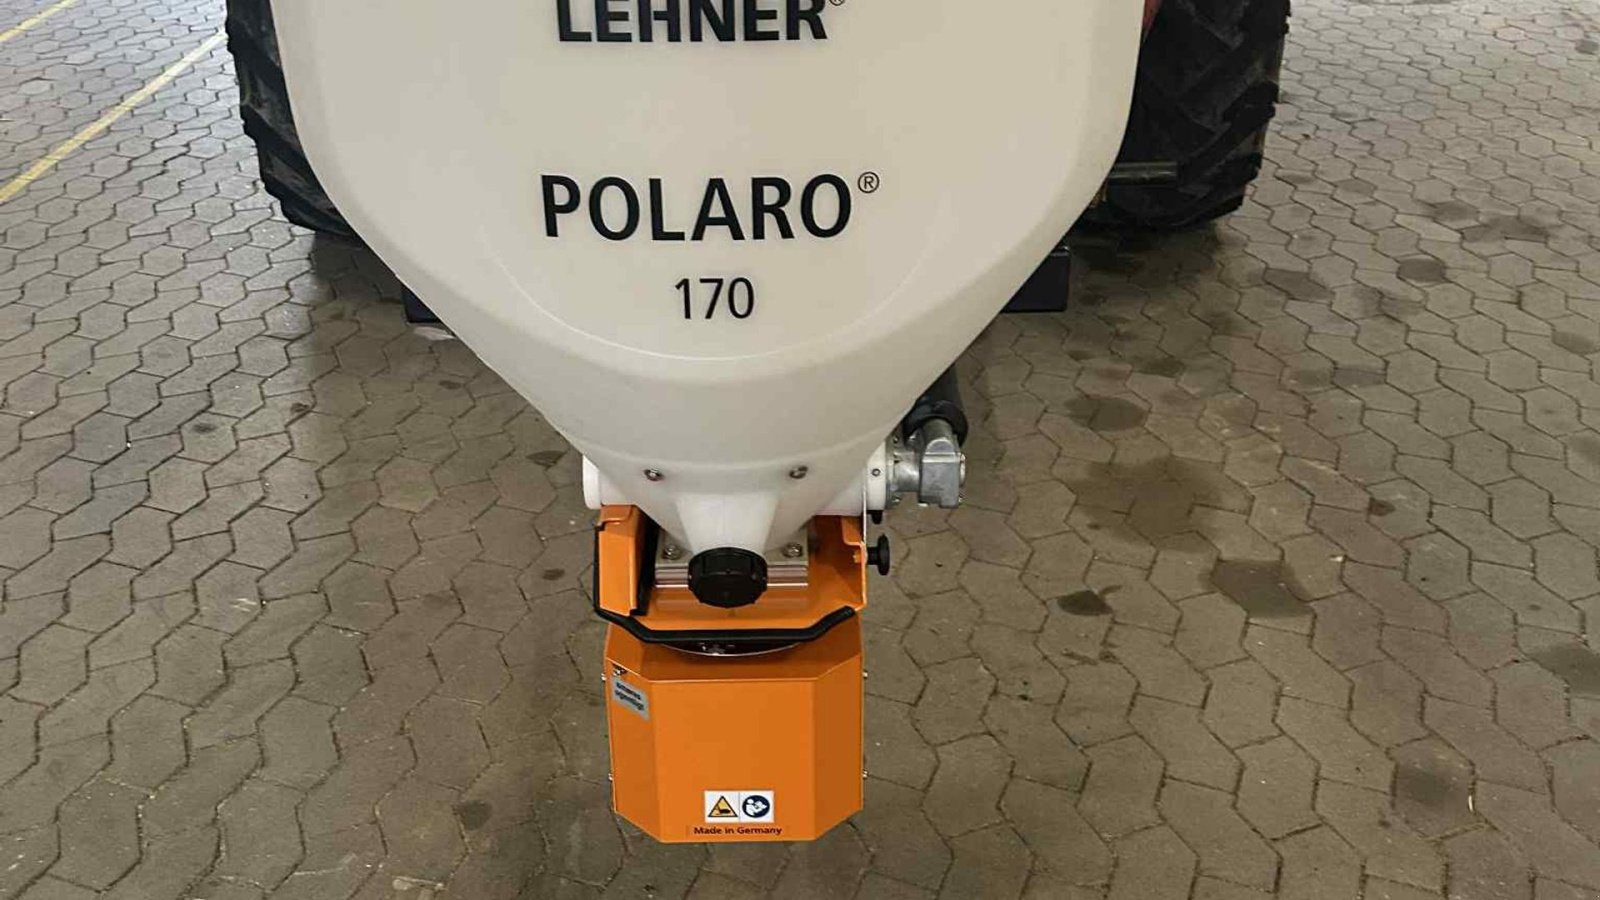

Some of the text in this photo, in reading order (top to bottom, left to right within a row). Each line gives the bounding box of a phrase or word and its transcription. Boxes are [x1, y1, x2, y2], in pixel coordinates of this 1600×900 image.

[556, 0, 845, 42] LEHNER
[675, 277, 755, 320] 170
[694, 827, 782, 836] Made in Germany
